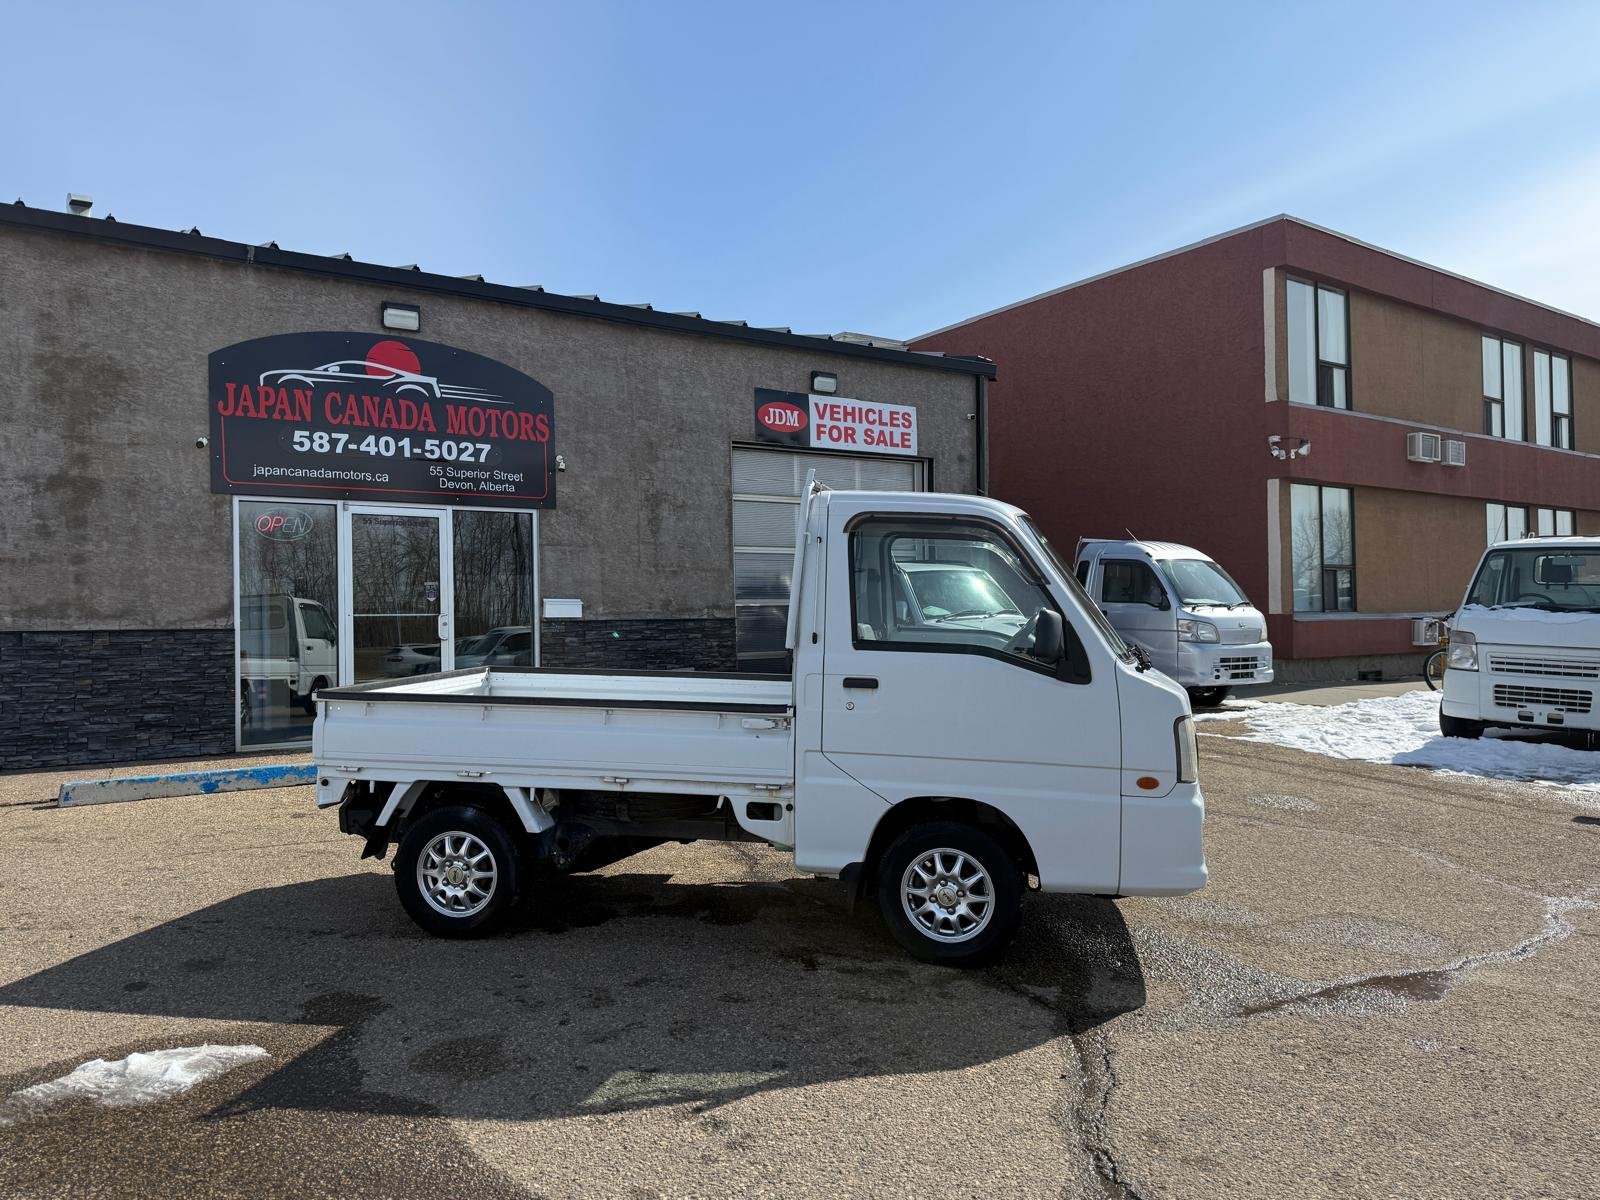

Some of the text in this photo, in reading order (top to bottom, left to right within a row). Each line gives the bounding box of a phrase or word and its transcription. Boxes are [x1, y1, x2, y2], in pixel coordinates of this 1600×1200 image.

[218, 383, 550, 442] JAPAN CANADA MOTORS
[765, 408, 799, 427] JDM
[814, 402, 912, 428] VEHICLES
[816, 424, 912, 448] FOR SALE
[292, 430, 491, 462] 587-401-5027
[252, 464, 389, 482] japancanadamotors.ca
[429, 466, 524, 482] 55 Superior Street
[439, 477, 515, 492] Devon, Alberta
[257, 514, 308, 532] OPEN
